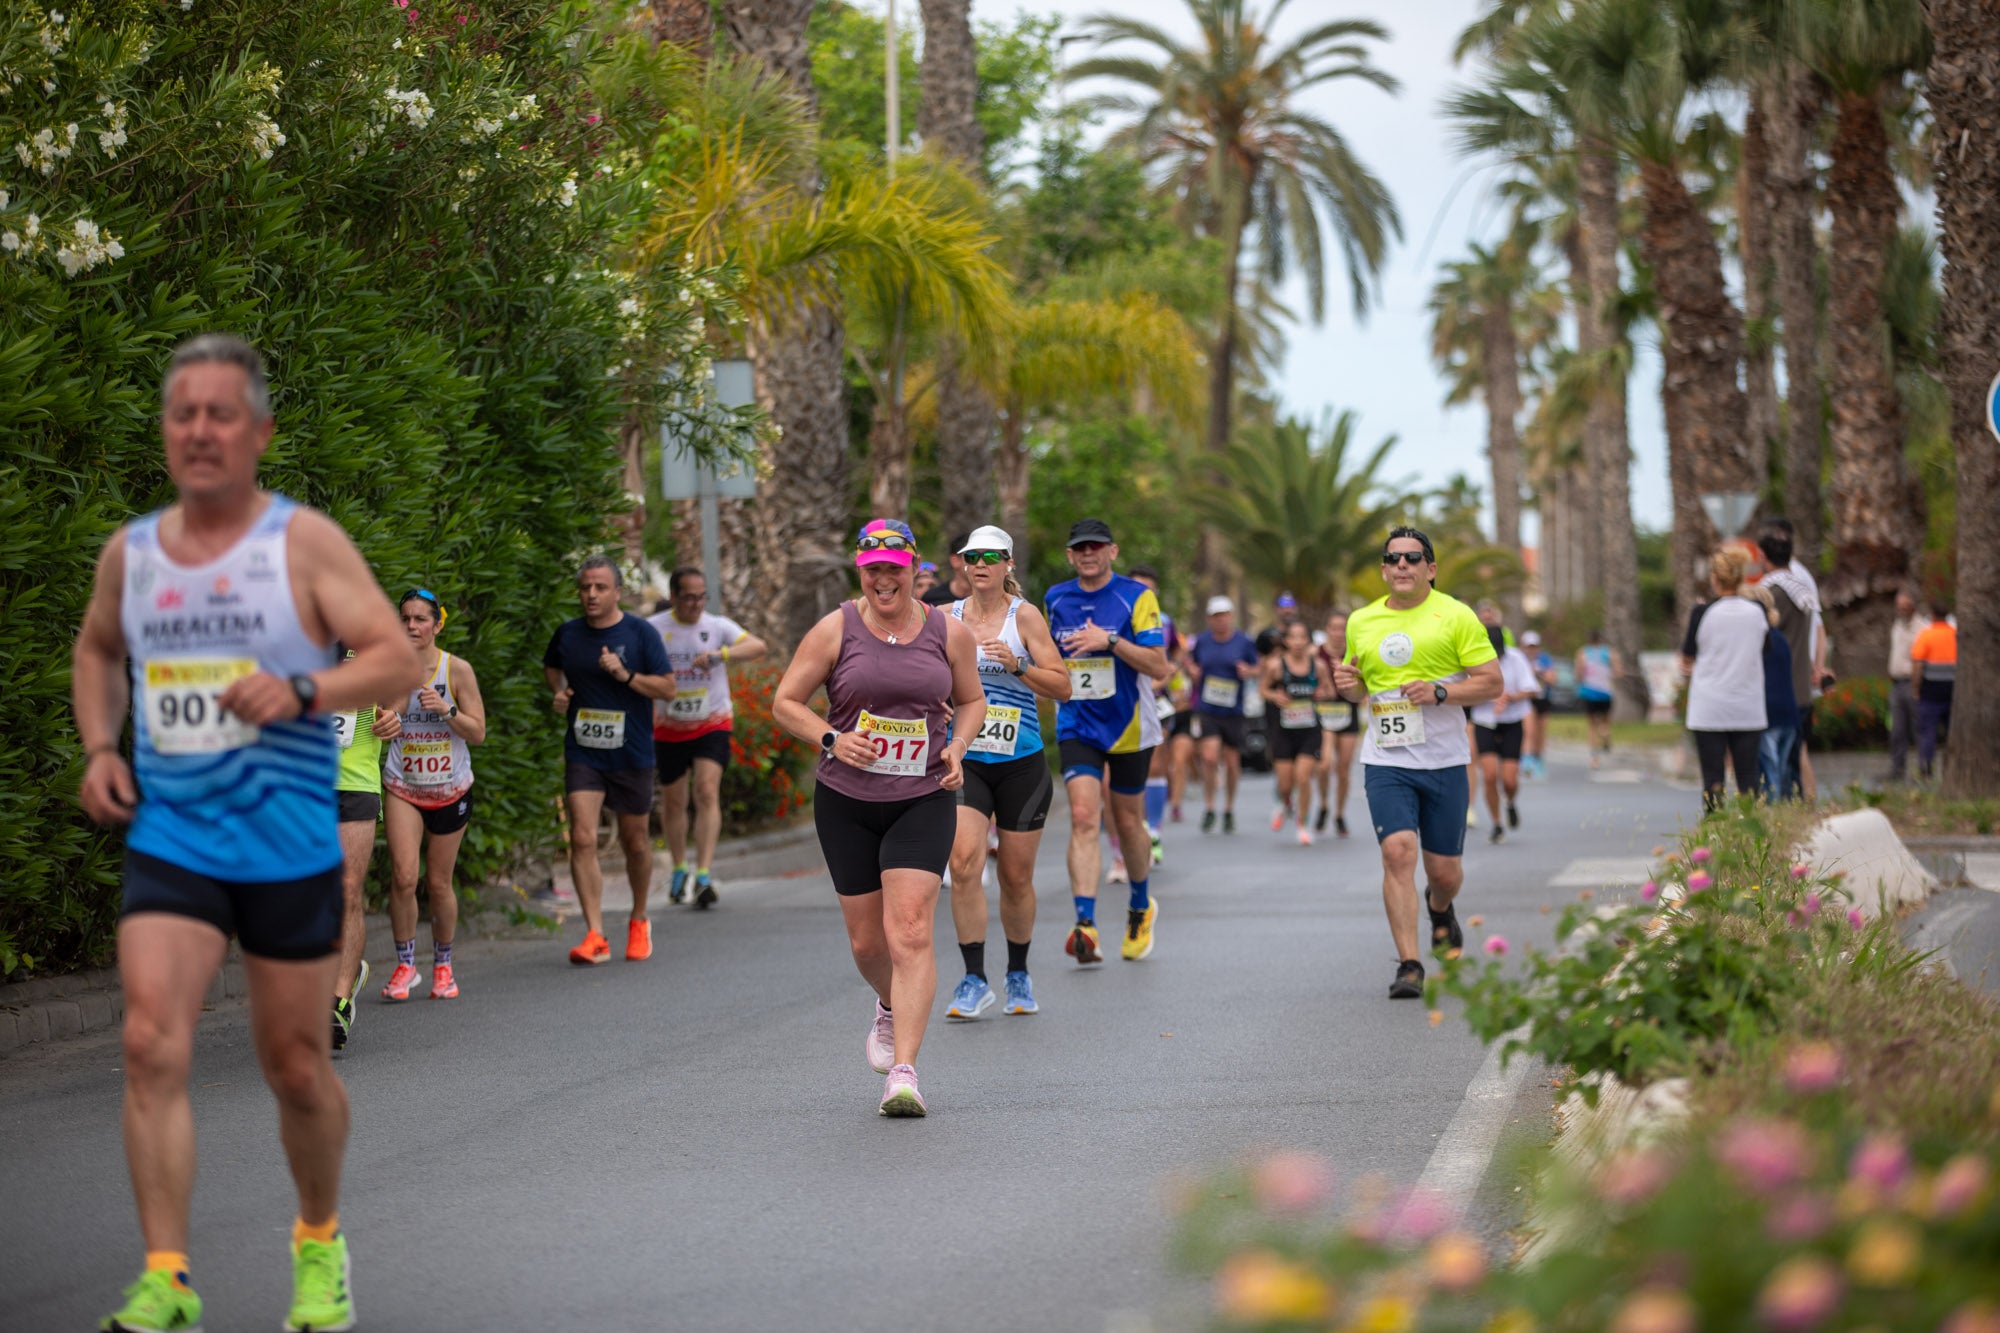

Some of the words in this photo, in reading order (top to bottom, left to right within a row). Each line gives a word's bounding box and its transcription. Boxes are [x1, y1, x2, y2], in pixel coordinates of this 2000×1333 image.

[1080, 673, 1092, 688] 2
[674, 699, 702, 713] 437
[581, 723, 615, 739] 295
[876, 723, 916, 734] FONDO
[1380, 717, 1406, 735] 55
[863, 736, 926, 761] 017
[402, 756, 451, 773] 2102
